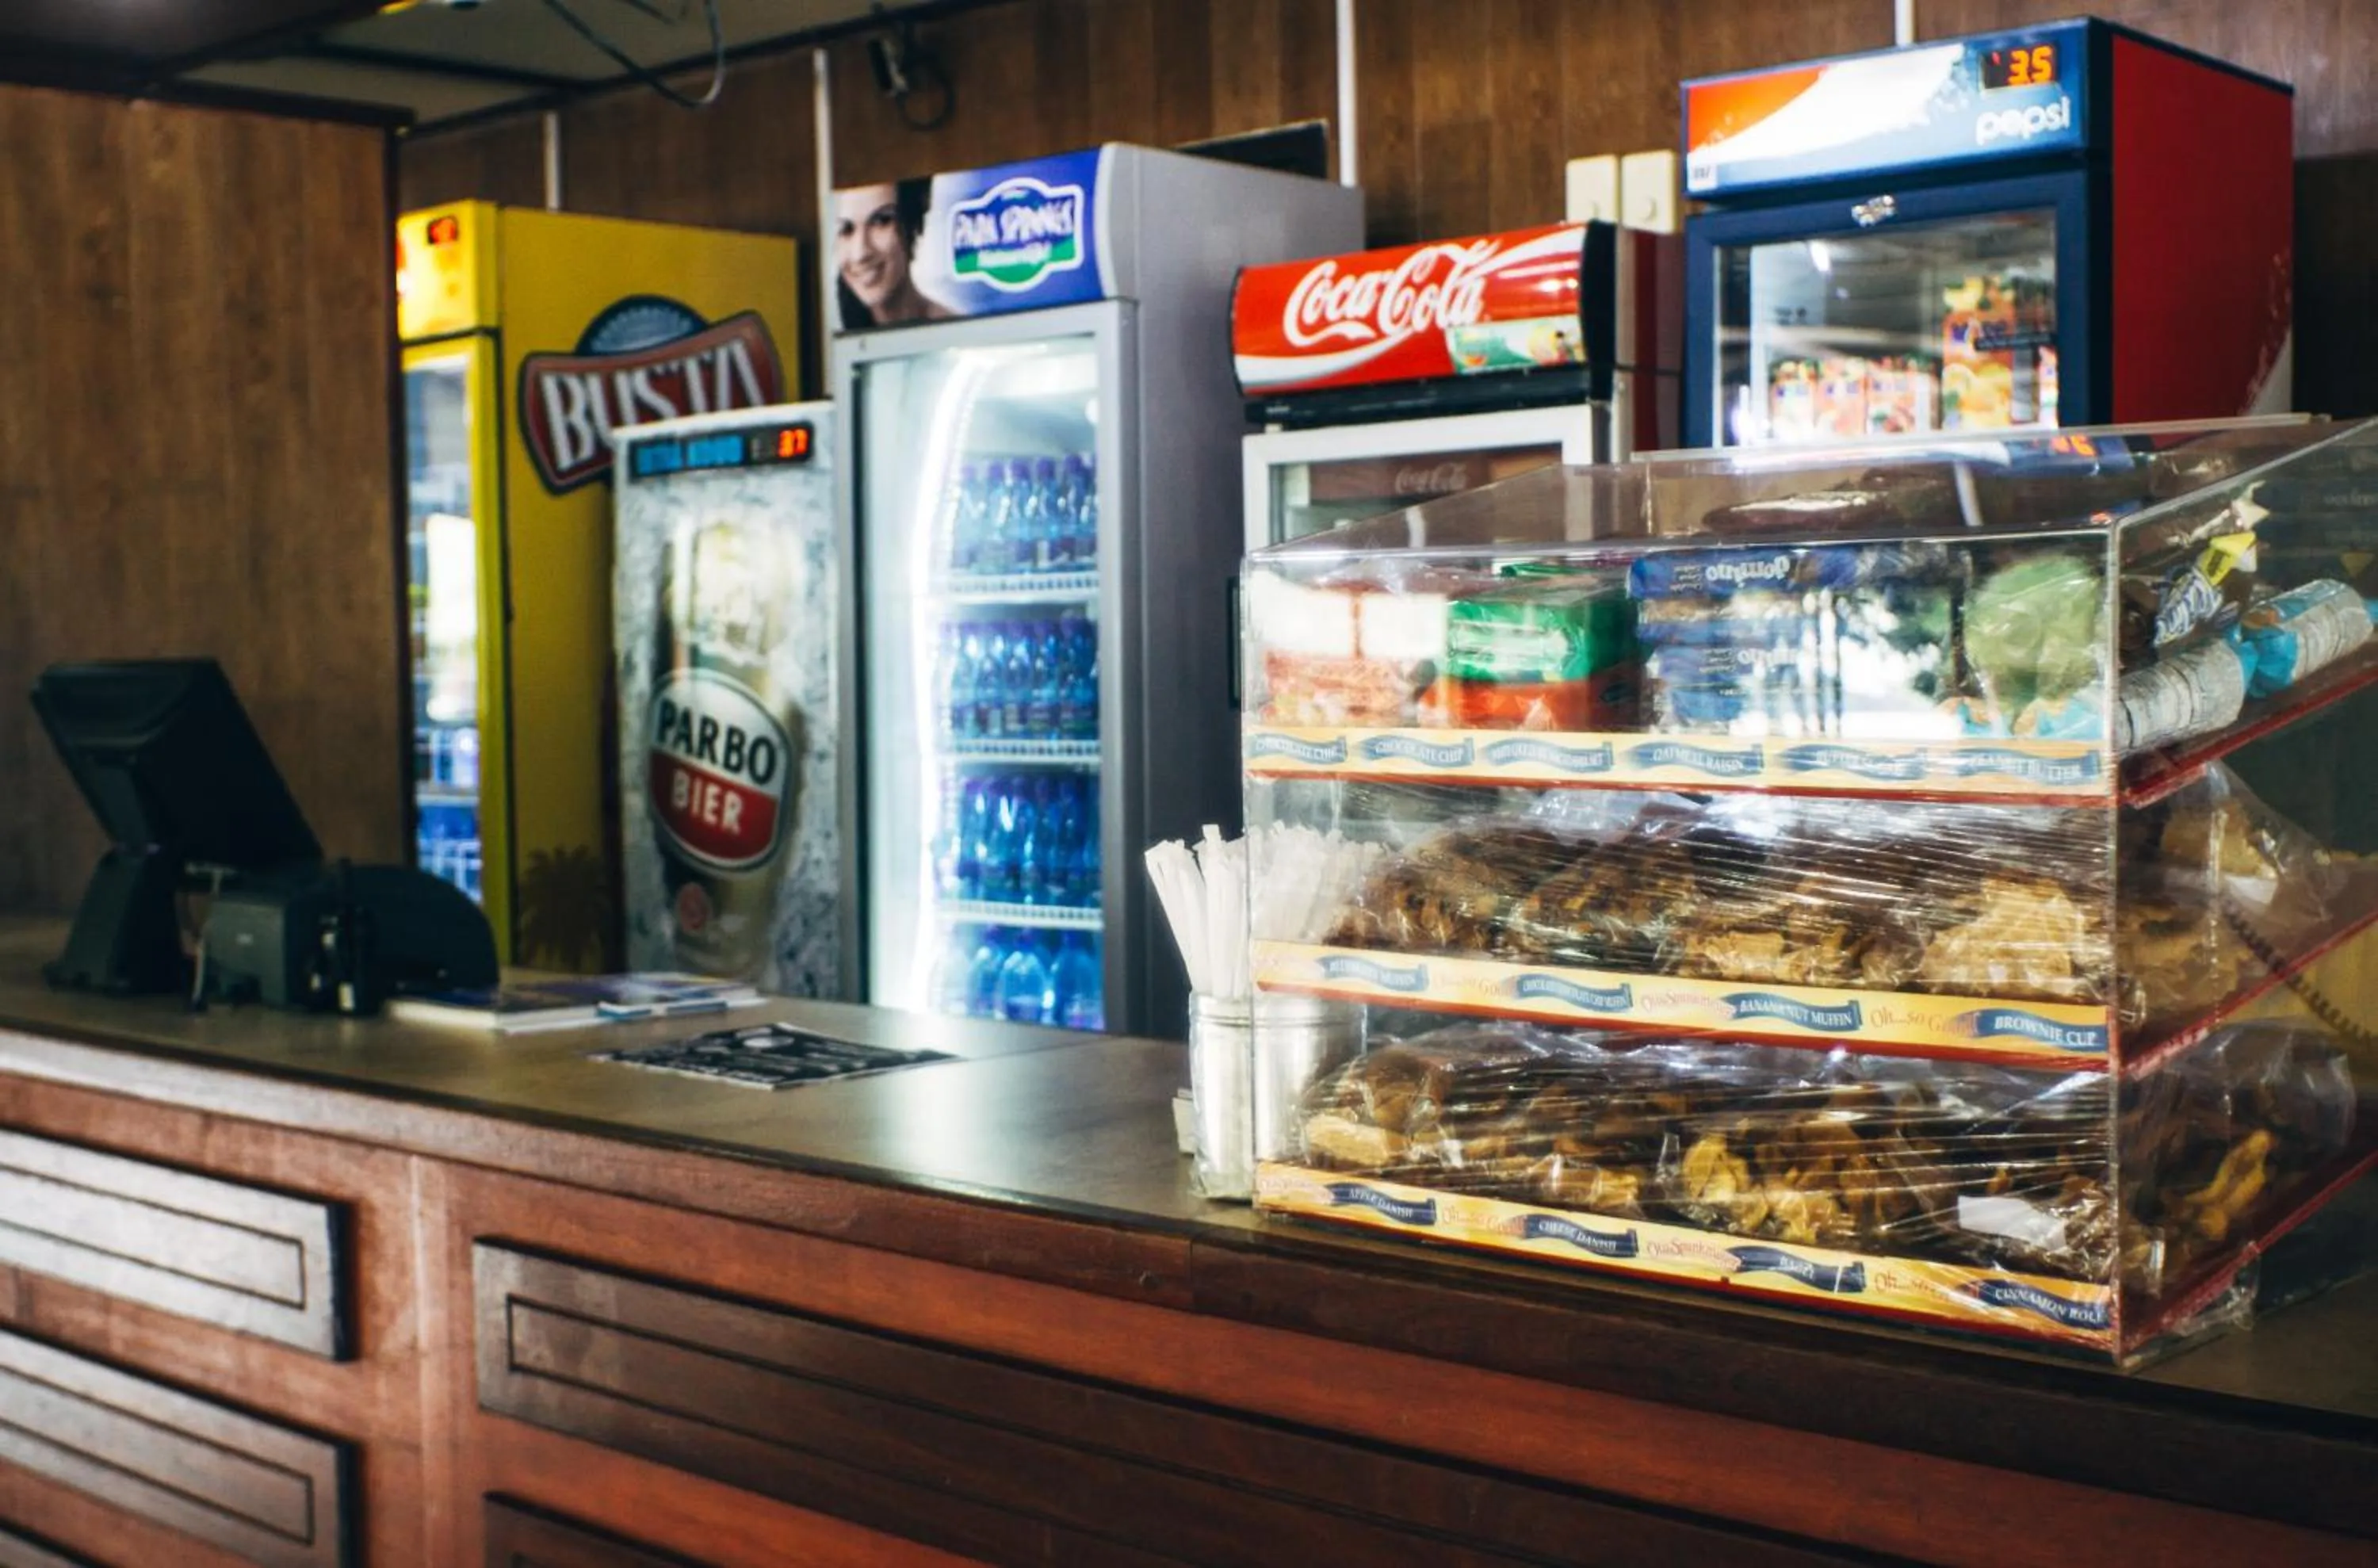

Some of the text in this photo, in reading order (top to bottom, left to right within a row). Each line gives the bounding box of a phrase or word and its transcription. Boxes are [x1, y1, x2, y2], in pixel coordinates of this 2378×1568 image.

[1976, 95, 2070, 146] pepsi
[657, 699, 778, 786] PARBO
[671, 768, 745, 835] BIER
[1811, 1011, 1852, 1027] MUFFIN
[1994, 1015, 2096, 1046] BROWNIE CUP
[1576, 1228, 1617, 1250] DANISH
[1994, 1287, 2066, 1320] CINNAMON
